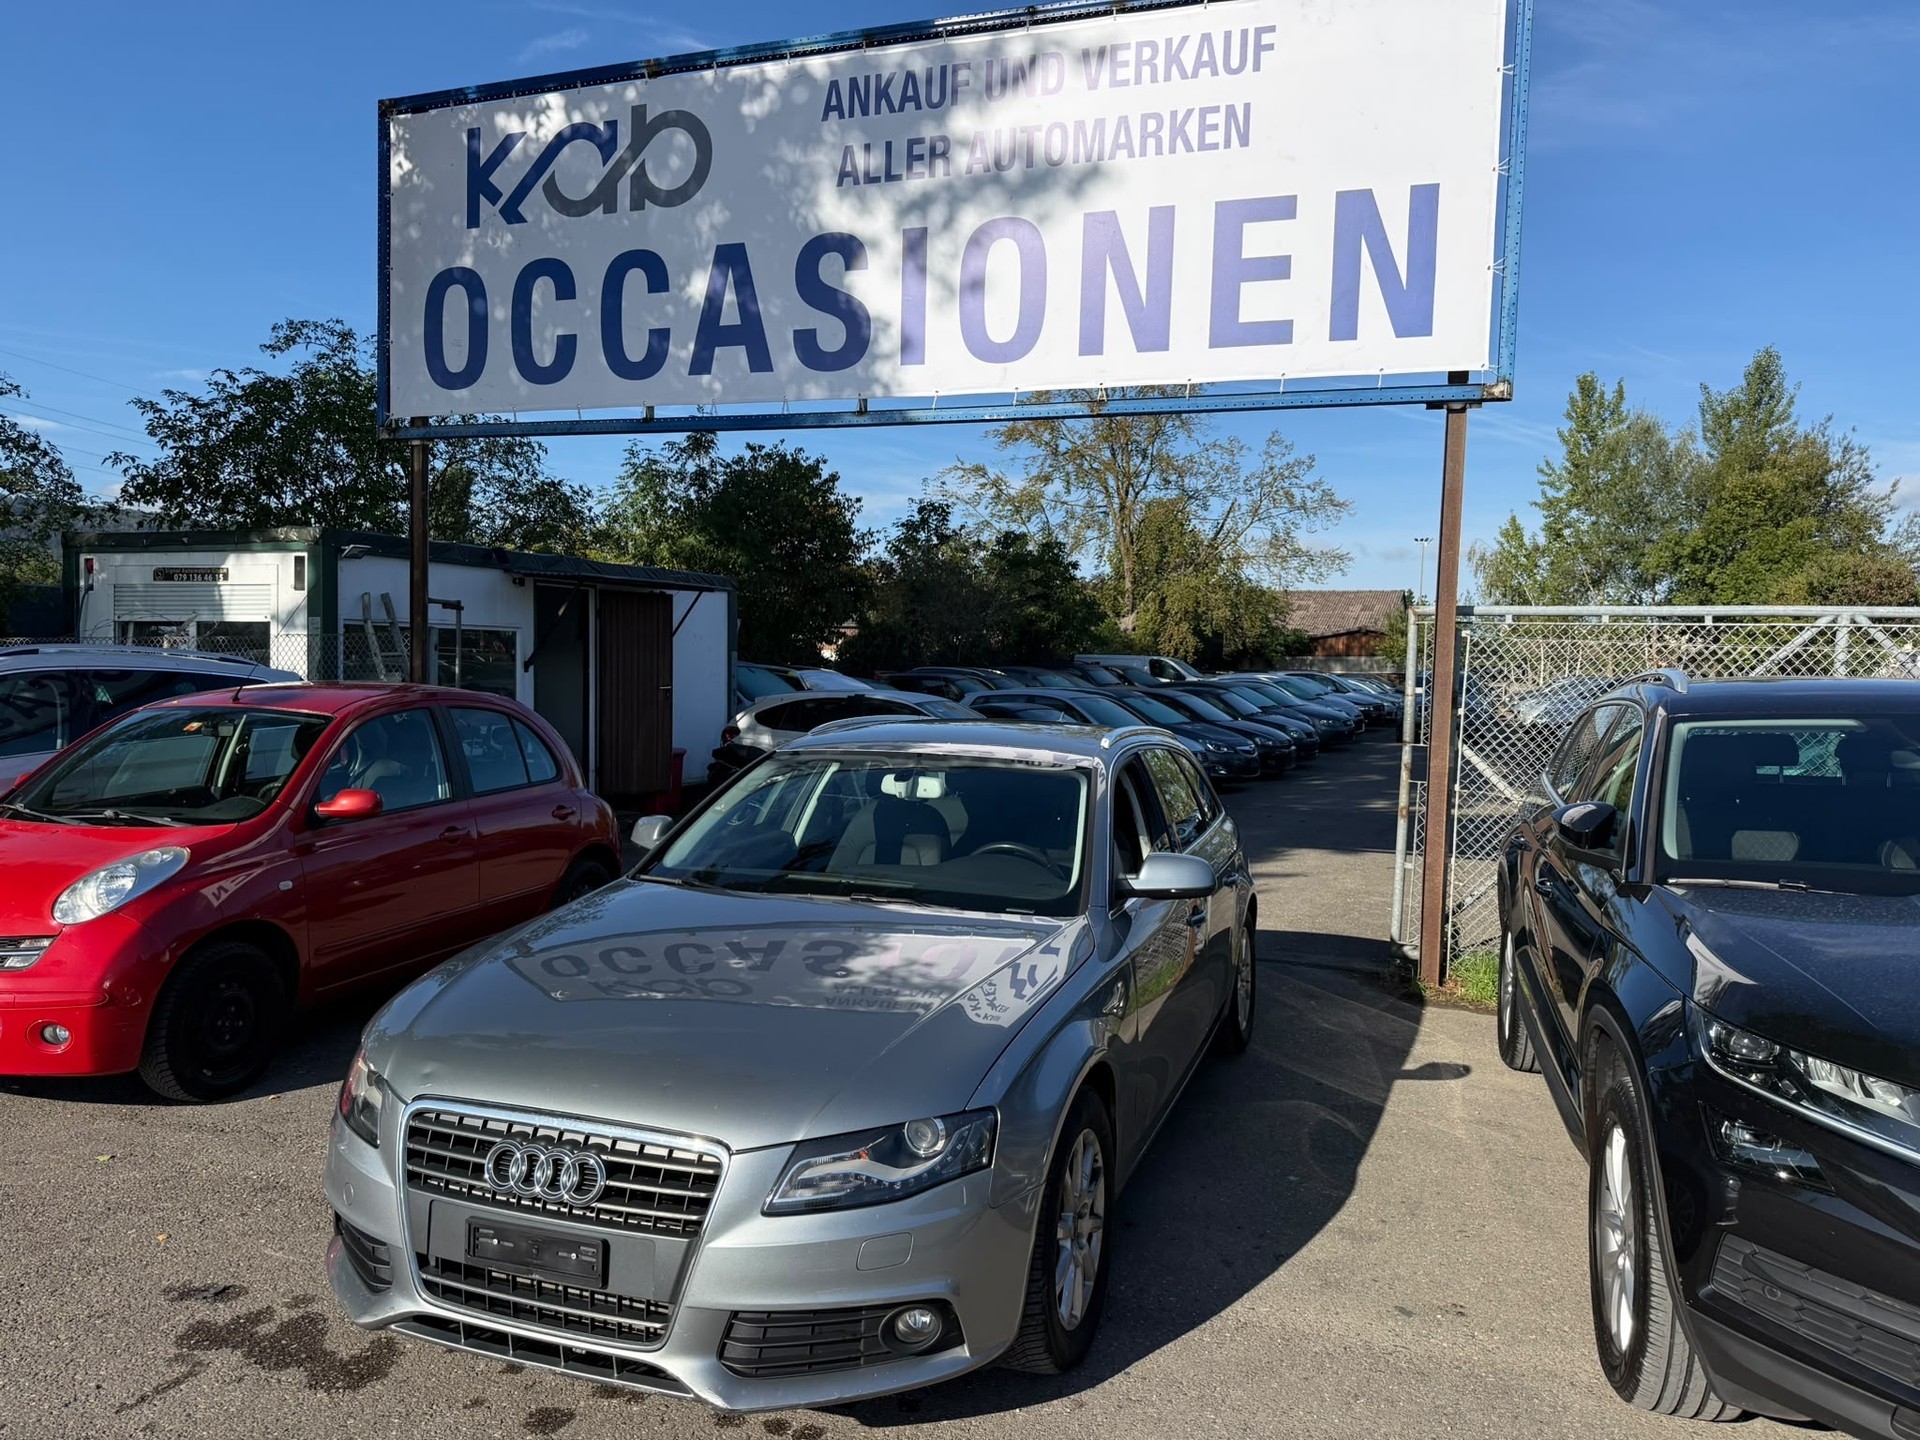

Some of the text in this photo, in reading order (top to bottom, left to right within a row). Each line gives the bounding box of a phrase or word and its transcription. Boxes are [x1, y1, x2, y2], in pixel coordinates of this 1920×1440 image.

[820, 24, 1278, 122] ANKAUF UND VERKAUF
[835, 102, 1252, 188] ALLER AUTOMARKEN
[423, 182, 1441, 391] OCCASIONEN
[173, 573, 188, 581] 079
[189, 573, 203, 581] 136
[204, 573, 213, 581] 46
